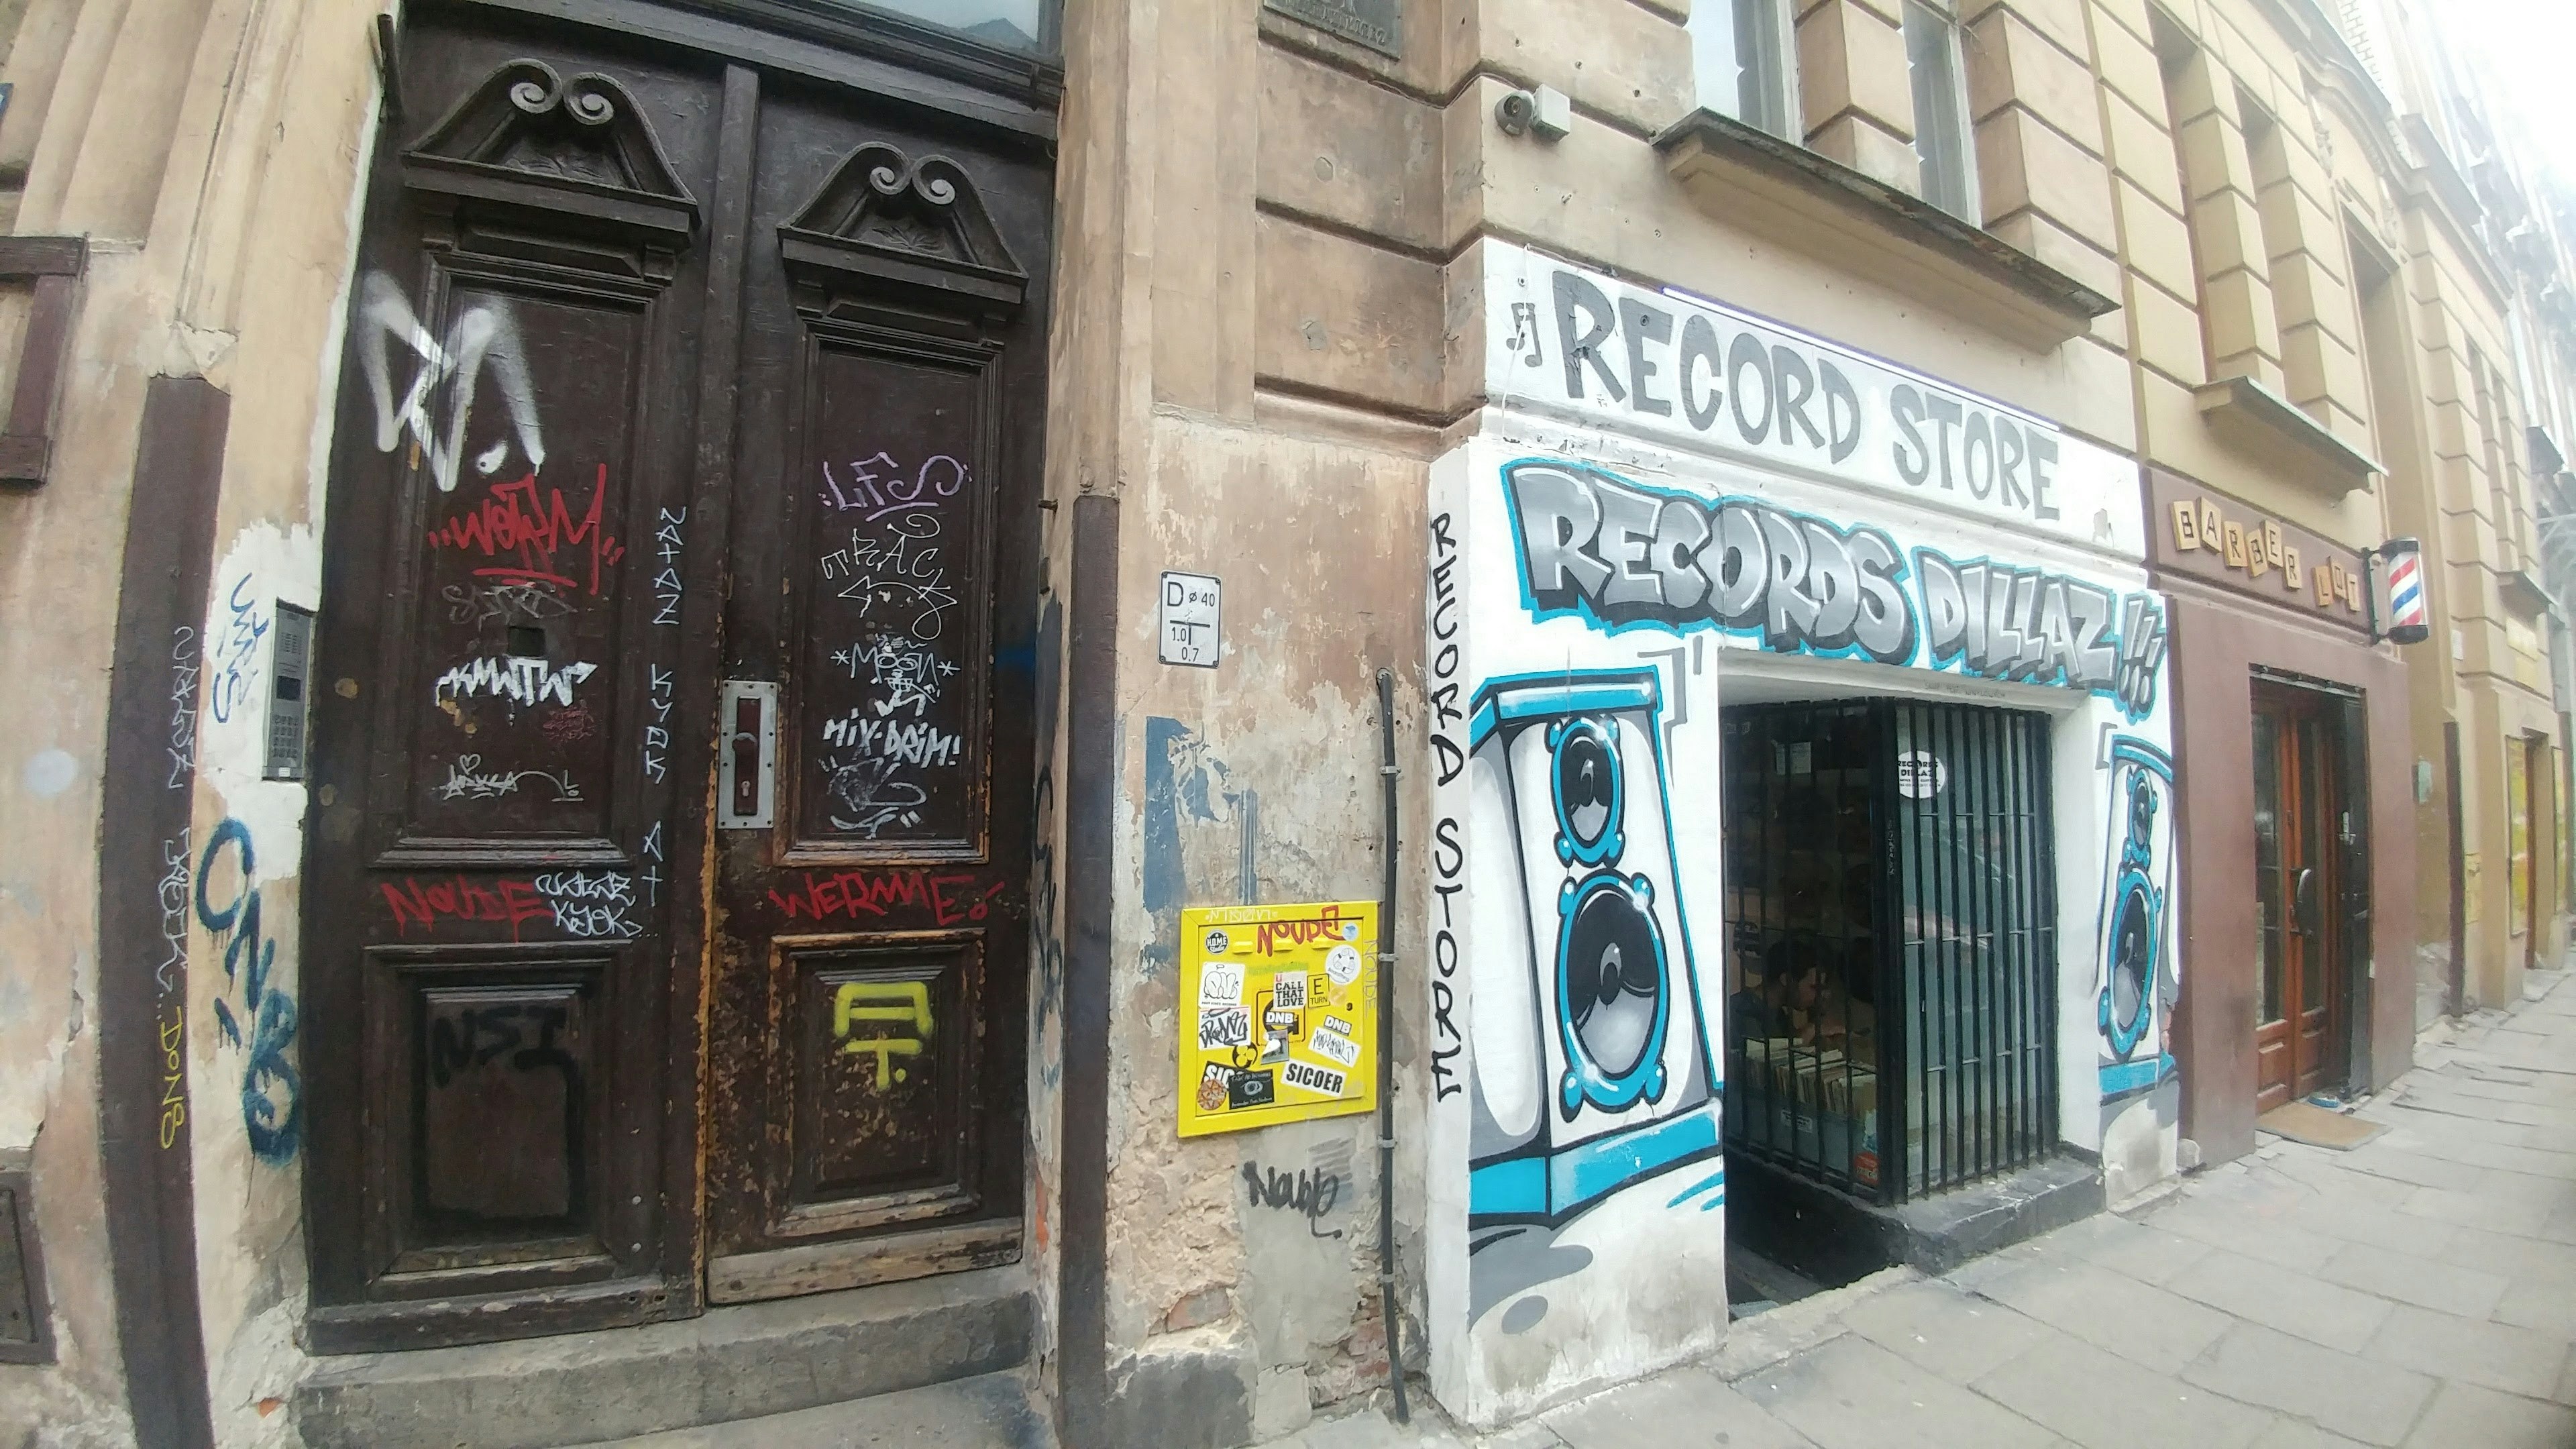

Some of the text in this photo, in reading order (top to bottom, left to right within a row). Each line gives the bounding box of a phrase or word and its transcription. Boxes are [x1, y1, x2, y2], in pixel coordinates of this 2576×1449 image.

[1551, 270, 2061, 521] RECORD STORE
[2180, 508, 2300, 581] BARBER
[1507, 464, 1915, 661] RECORDS
[1916, 547, 2118, 690] DILLAZ
[1167, 581, 1184, 606] D
[1201, 592, 1216, 607] 40
[1171, 627, 1187, 642] 1.0
[1181, 646, 1199, 662] 0.7
[1430, 513, 1464, 1103] RECORD STORE
[1275, 981, 1303, 991] CALL
[1276, 989, 1304, 999] THAT
[1313, 977, 1324, 996] E
[1277, 998, 1304, 1008] LOVE
[1310, 996, 1328, 1005] TURN
[1266, 1012, 1295, 1024] DNB
[1324, 1015, 1352, 1034] DNB
[1286, 1063, 1344, 1093] SICOER
